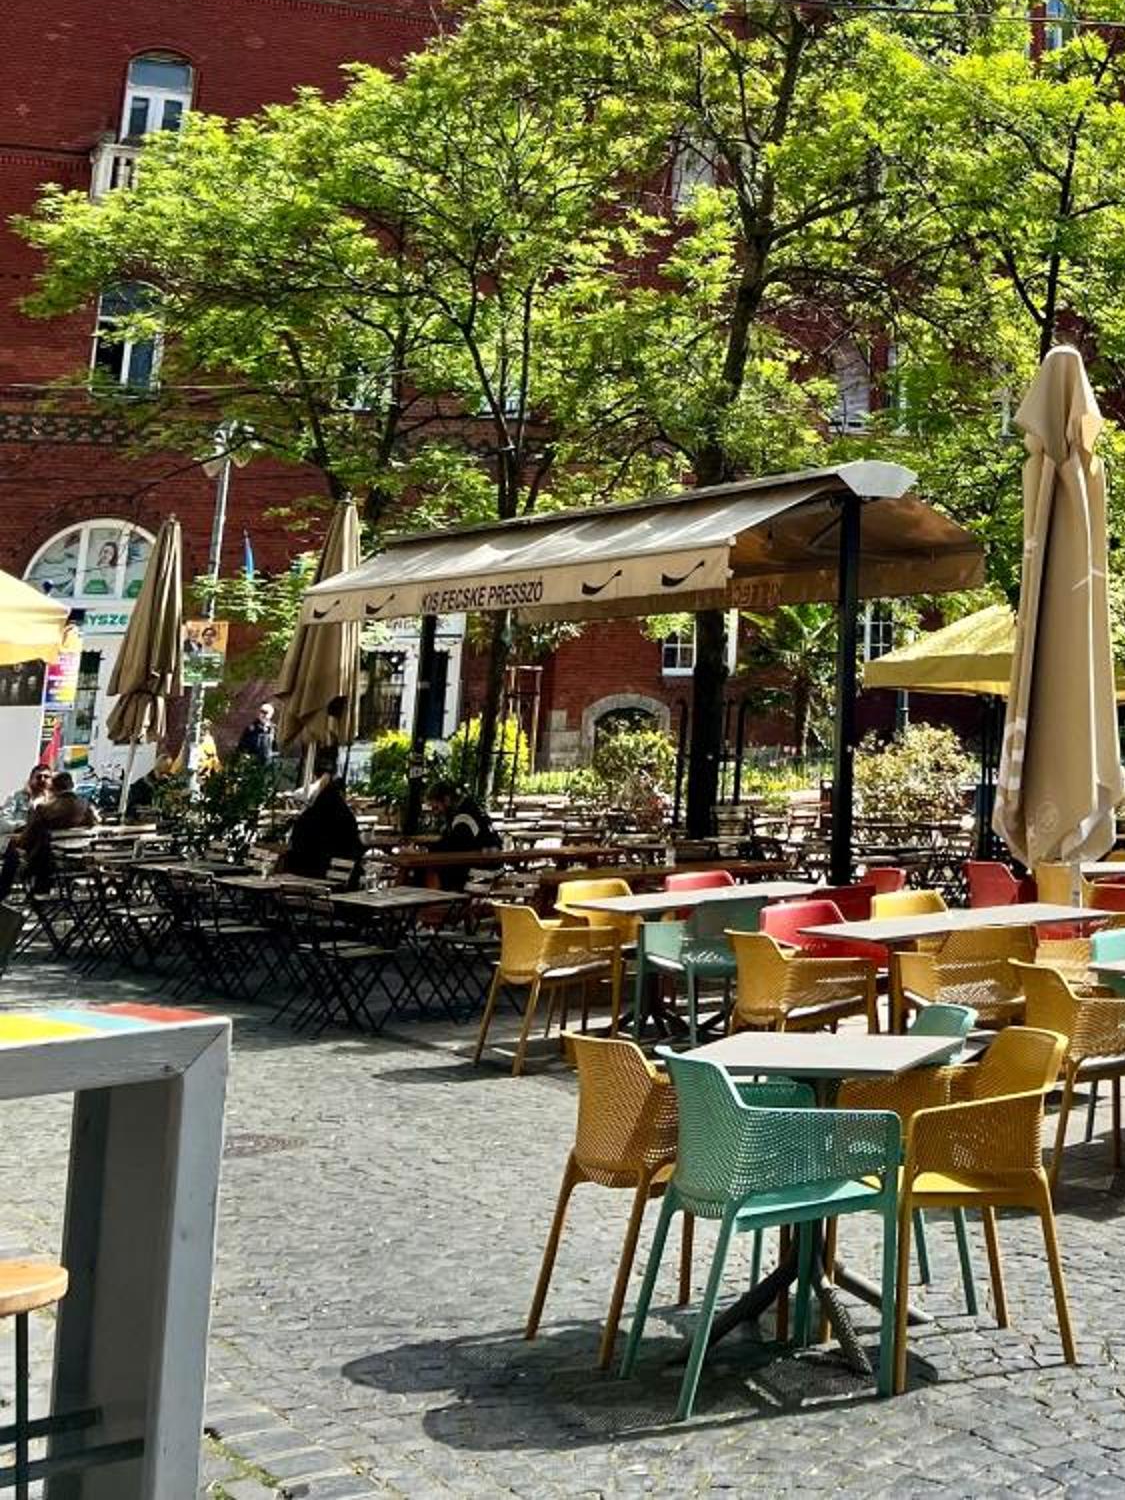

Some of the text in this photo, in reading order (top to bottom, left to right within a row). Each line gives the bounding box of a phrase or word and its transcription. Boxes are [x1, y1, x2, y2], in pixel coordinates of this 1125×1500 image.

[422, 575, 544, 612] KIS FECSKE PRESSZÓ
